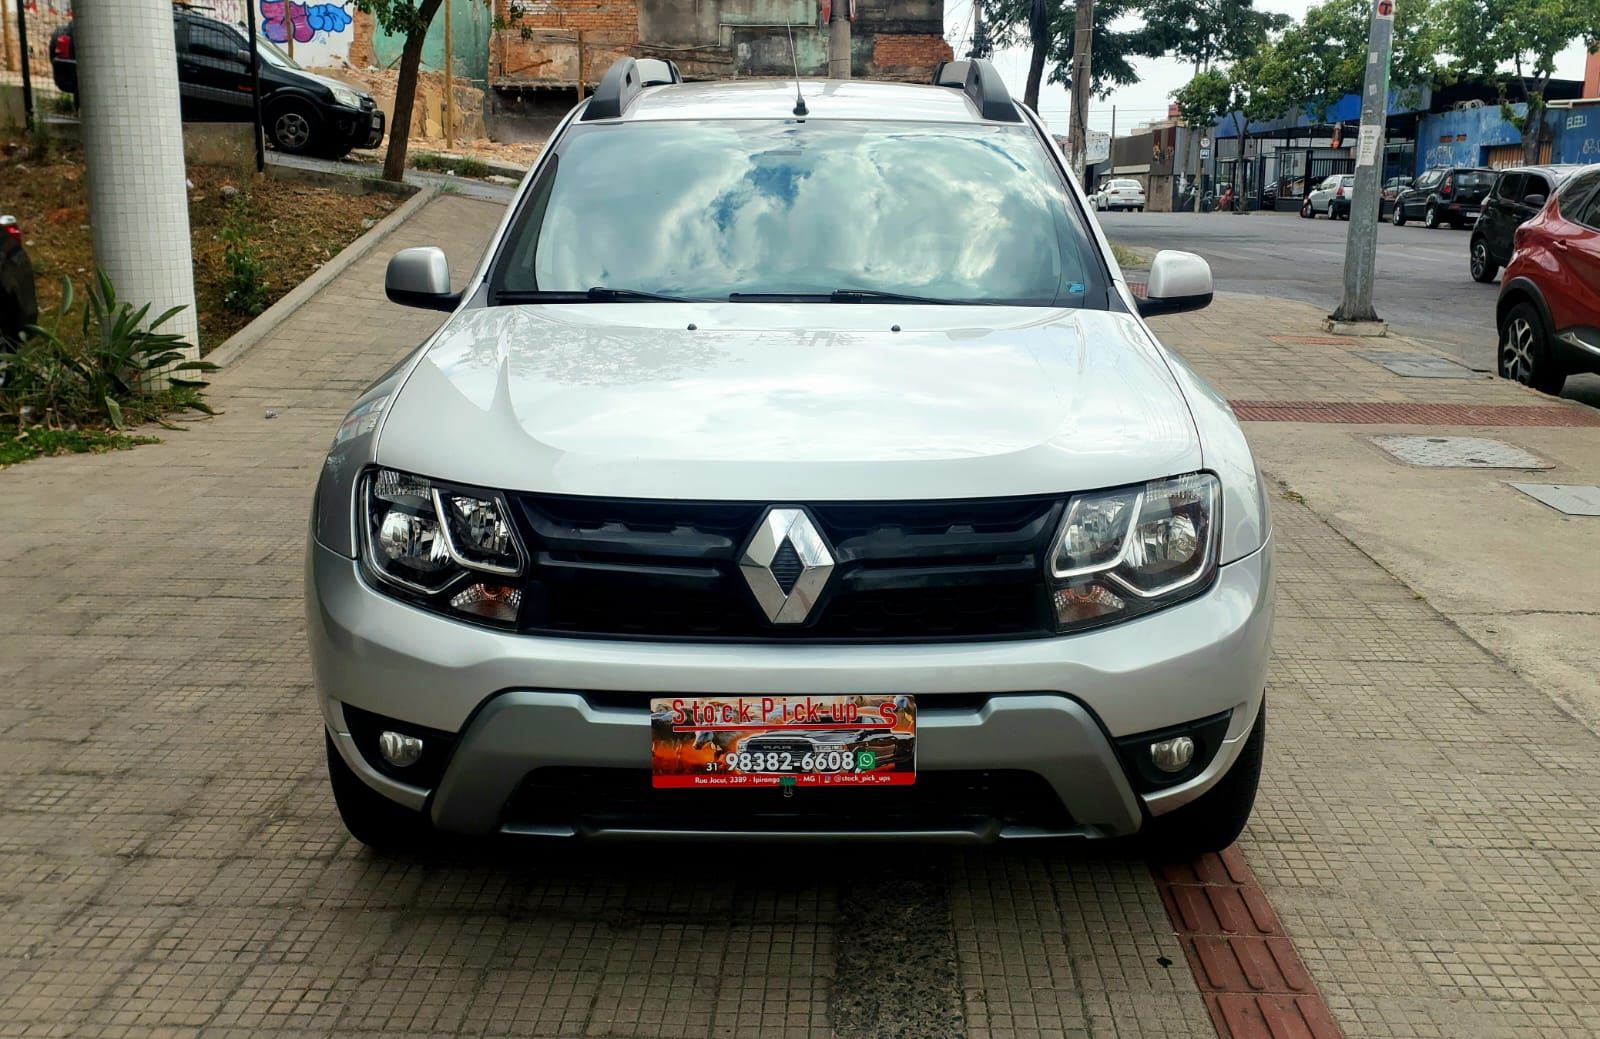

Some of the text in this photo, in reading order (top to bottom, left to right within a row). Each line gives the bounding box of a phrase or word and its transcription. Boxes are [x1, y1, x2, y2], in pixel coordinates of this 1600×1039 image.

[672, 697, 753, 724] Stock
[761, 697, 858, 724] Pick-up
[706, 752, 854, 772] 31 98382-6608
[834, 775, 891, 783] @stock_pick_ups
